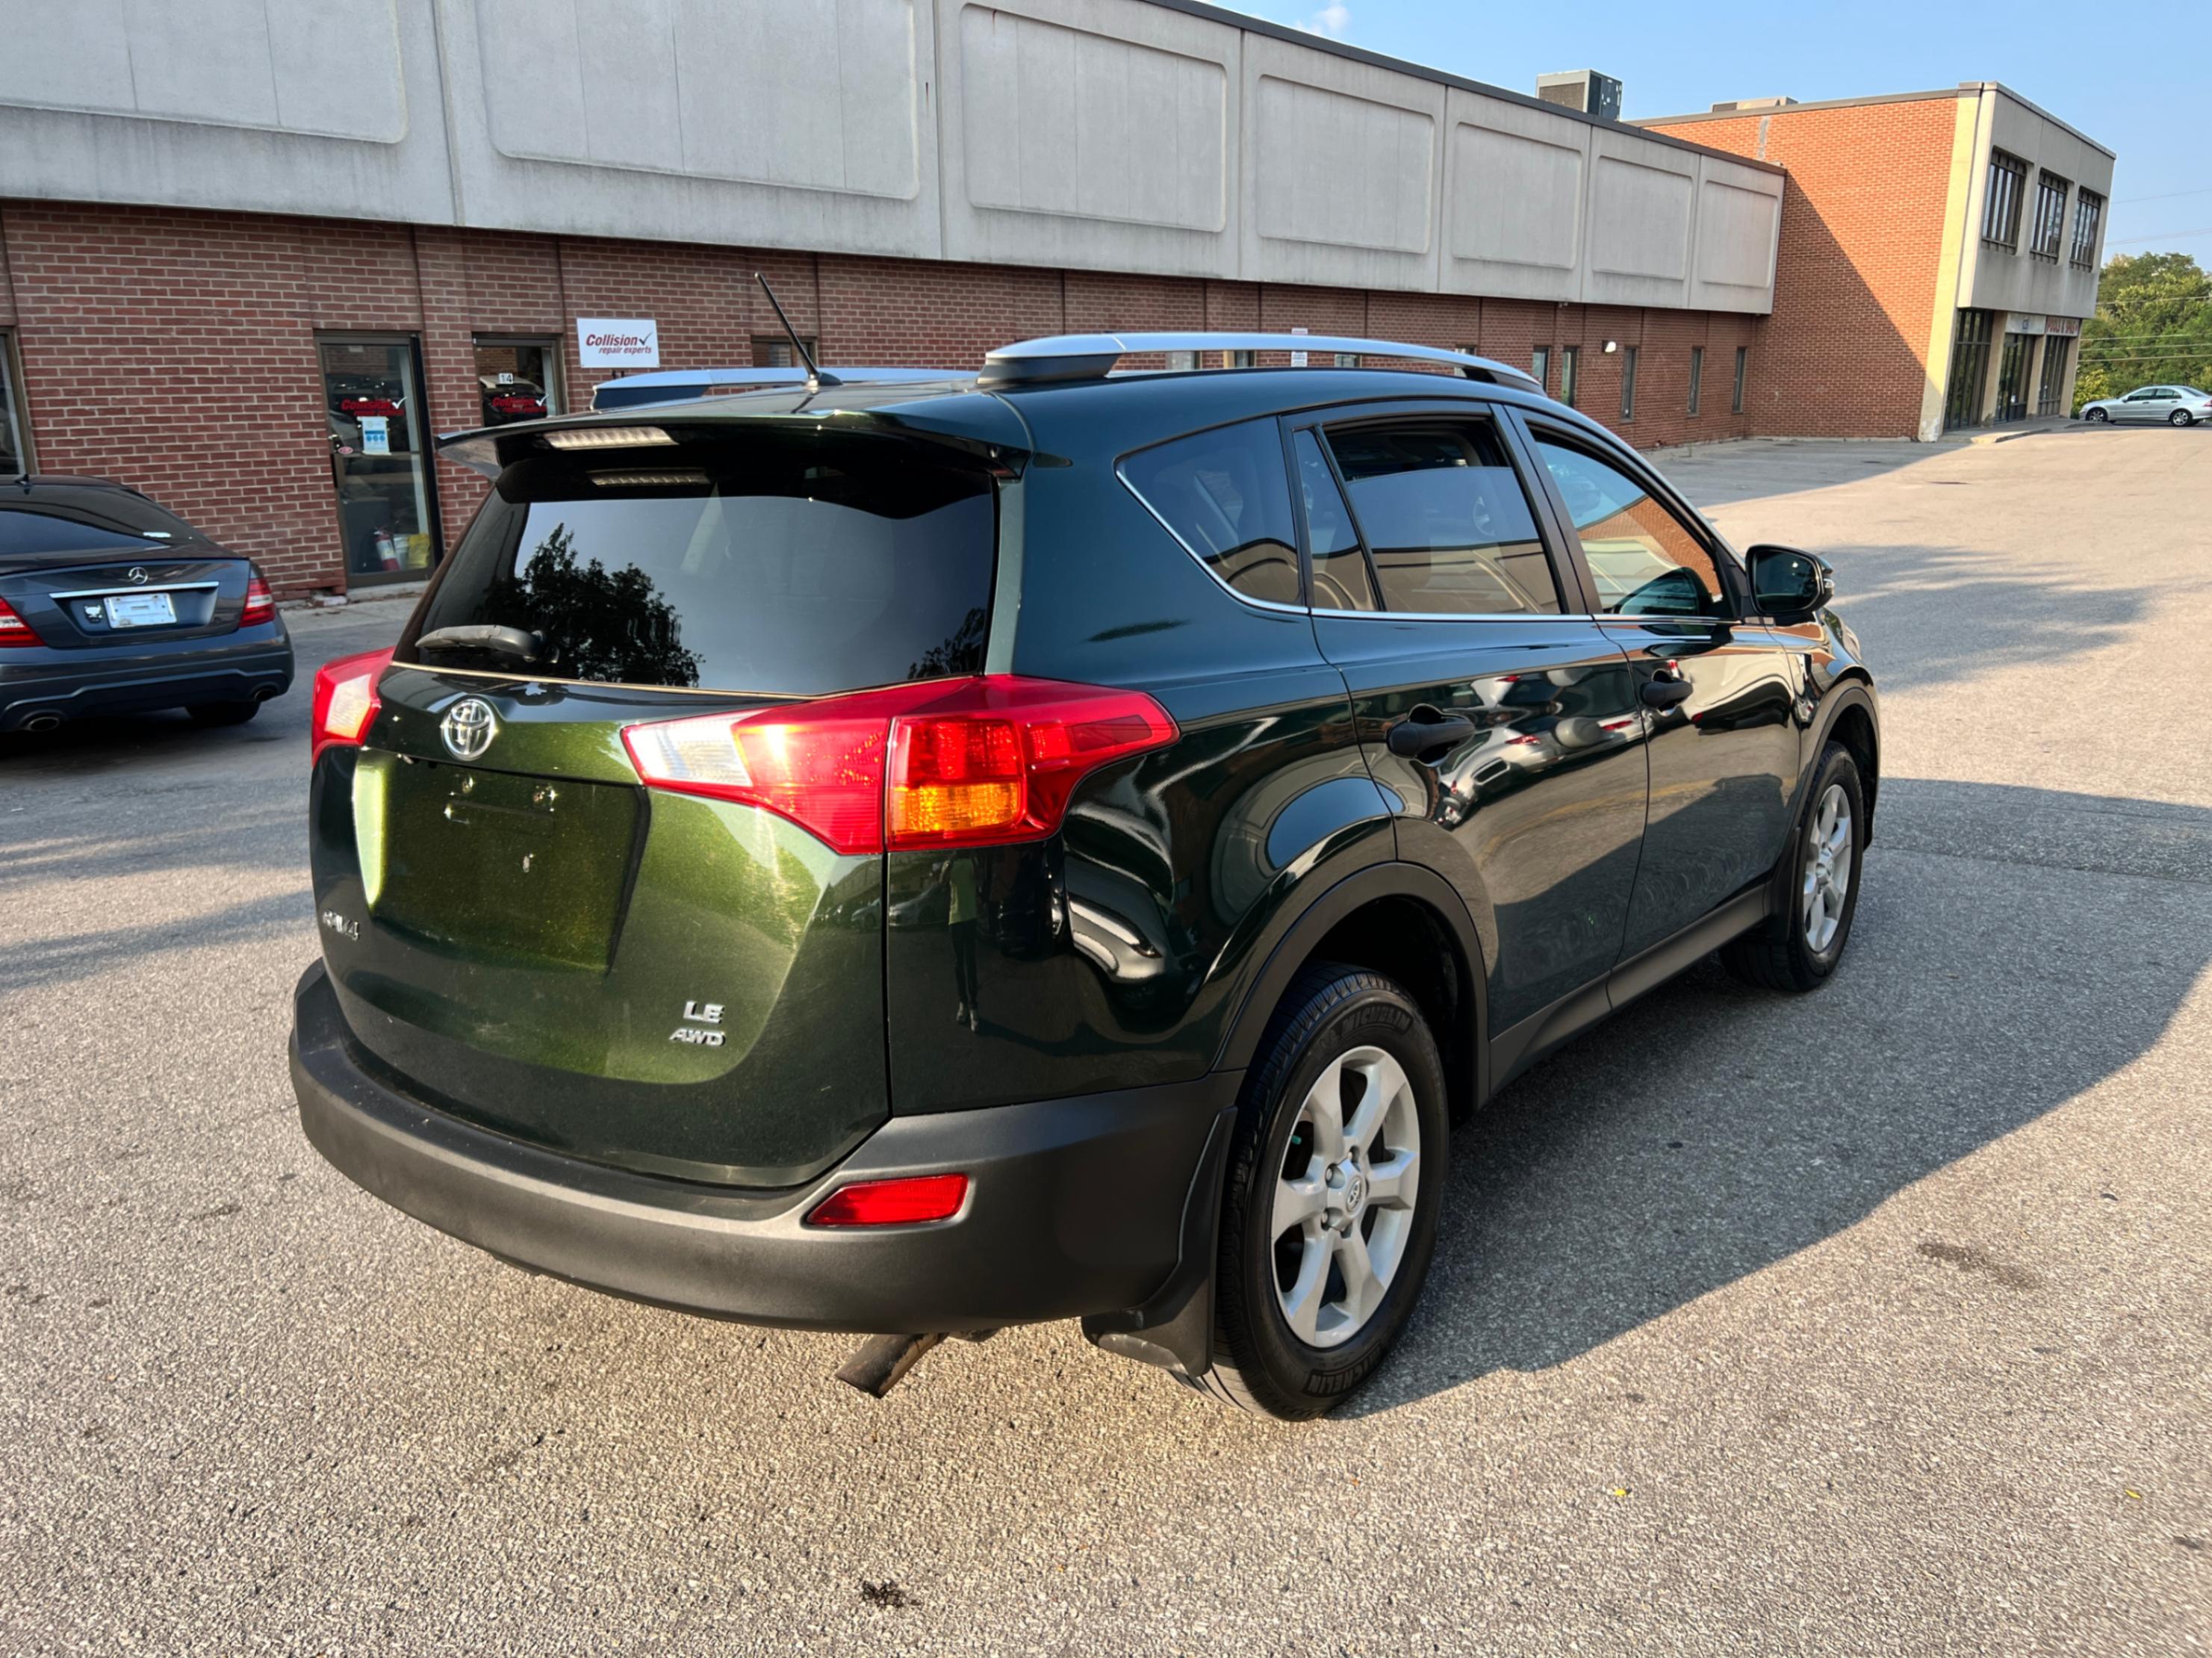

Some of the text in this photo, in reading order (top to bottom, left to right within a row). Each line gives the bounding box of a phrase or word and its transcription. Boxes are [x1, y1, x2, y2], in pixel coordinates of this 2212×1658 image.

[585, 334, 638, 346] Collision
[599, 346, 652, 355] repair experts
[501, 374, 512, 383] 14
[683, 1001, 725, 1024] LE
[1341, 1005, 1411, 1037] MICHELIN
[669, 1028, 726, 1046] AWD
